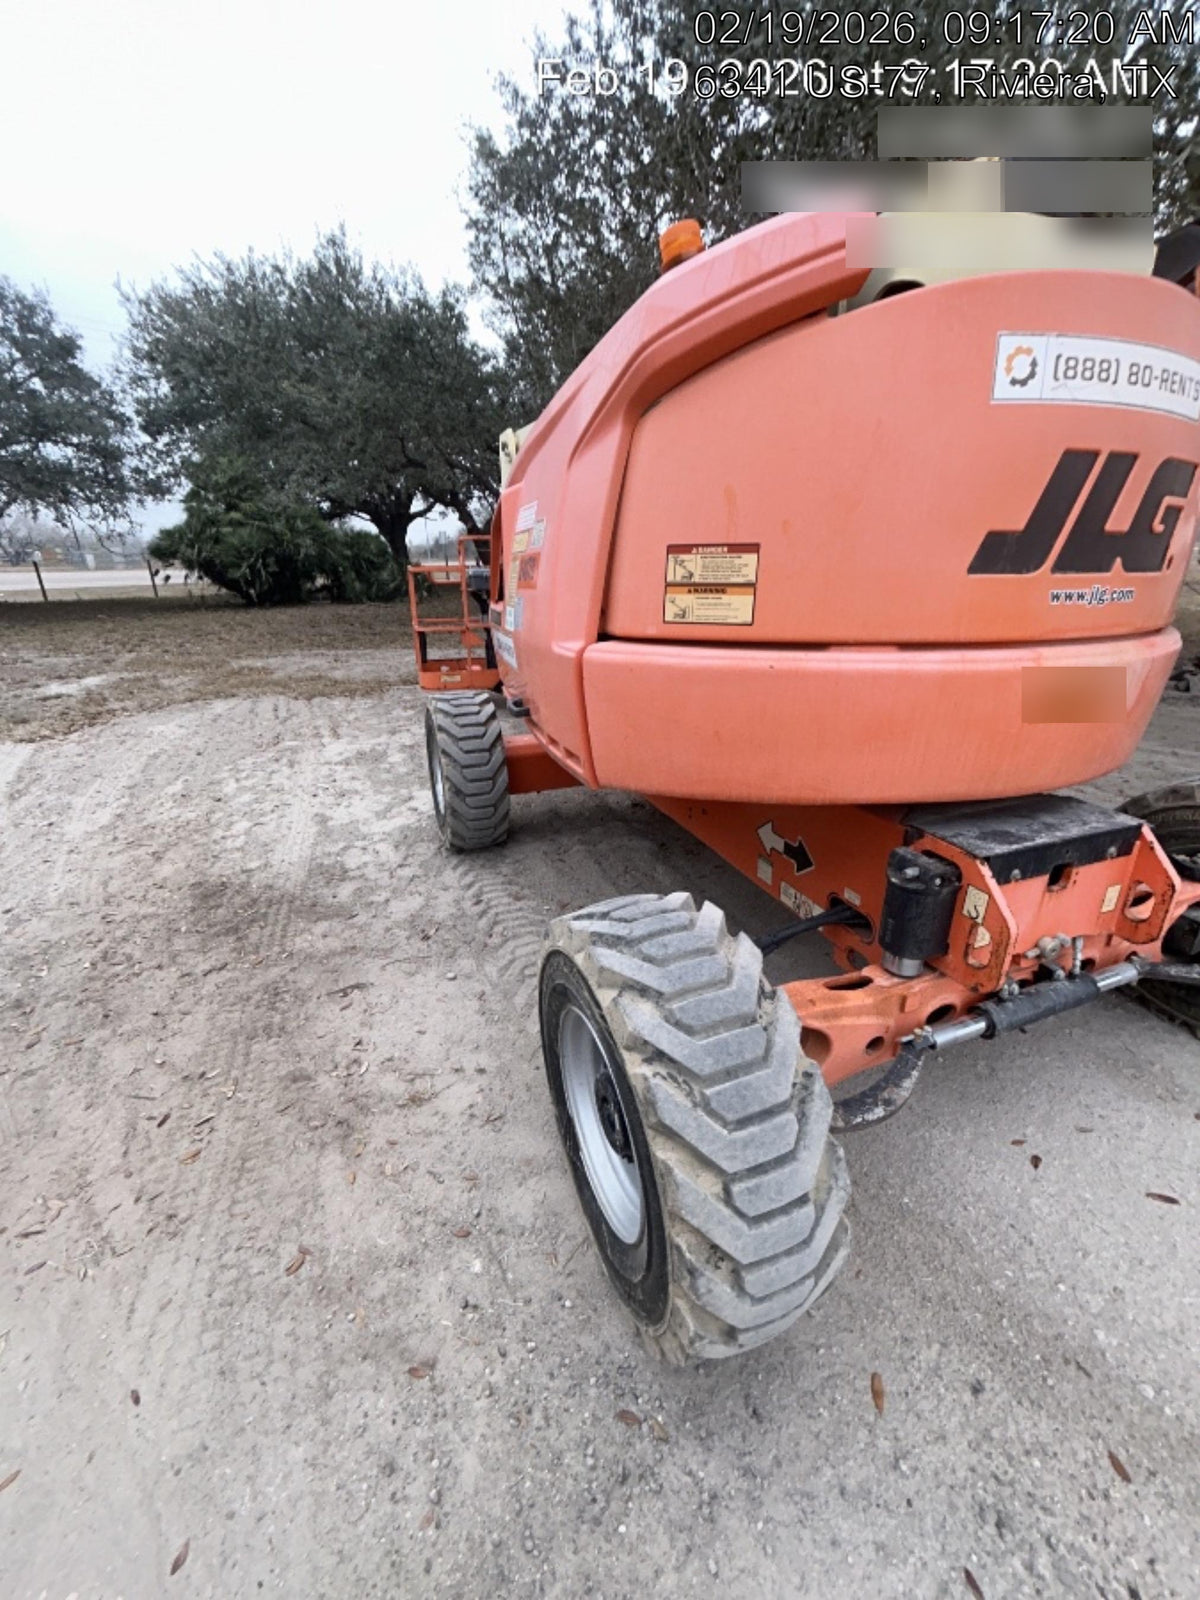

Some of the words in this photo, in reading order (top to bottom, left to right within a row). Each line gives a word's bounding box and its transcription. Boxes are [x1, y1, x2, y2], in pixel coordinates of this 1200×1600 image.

[1053, 353, 1120, 386] (888)
[1126, 362, 1200, 402] 80-RENTS
[966, 447, 1199, 575] JLG
[1050, 585, 1136, 606] www.jlg.com
